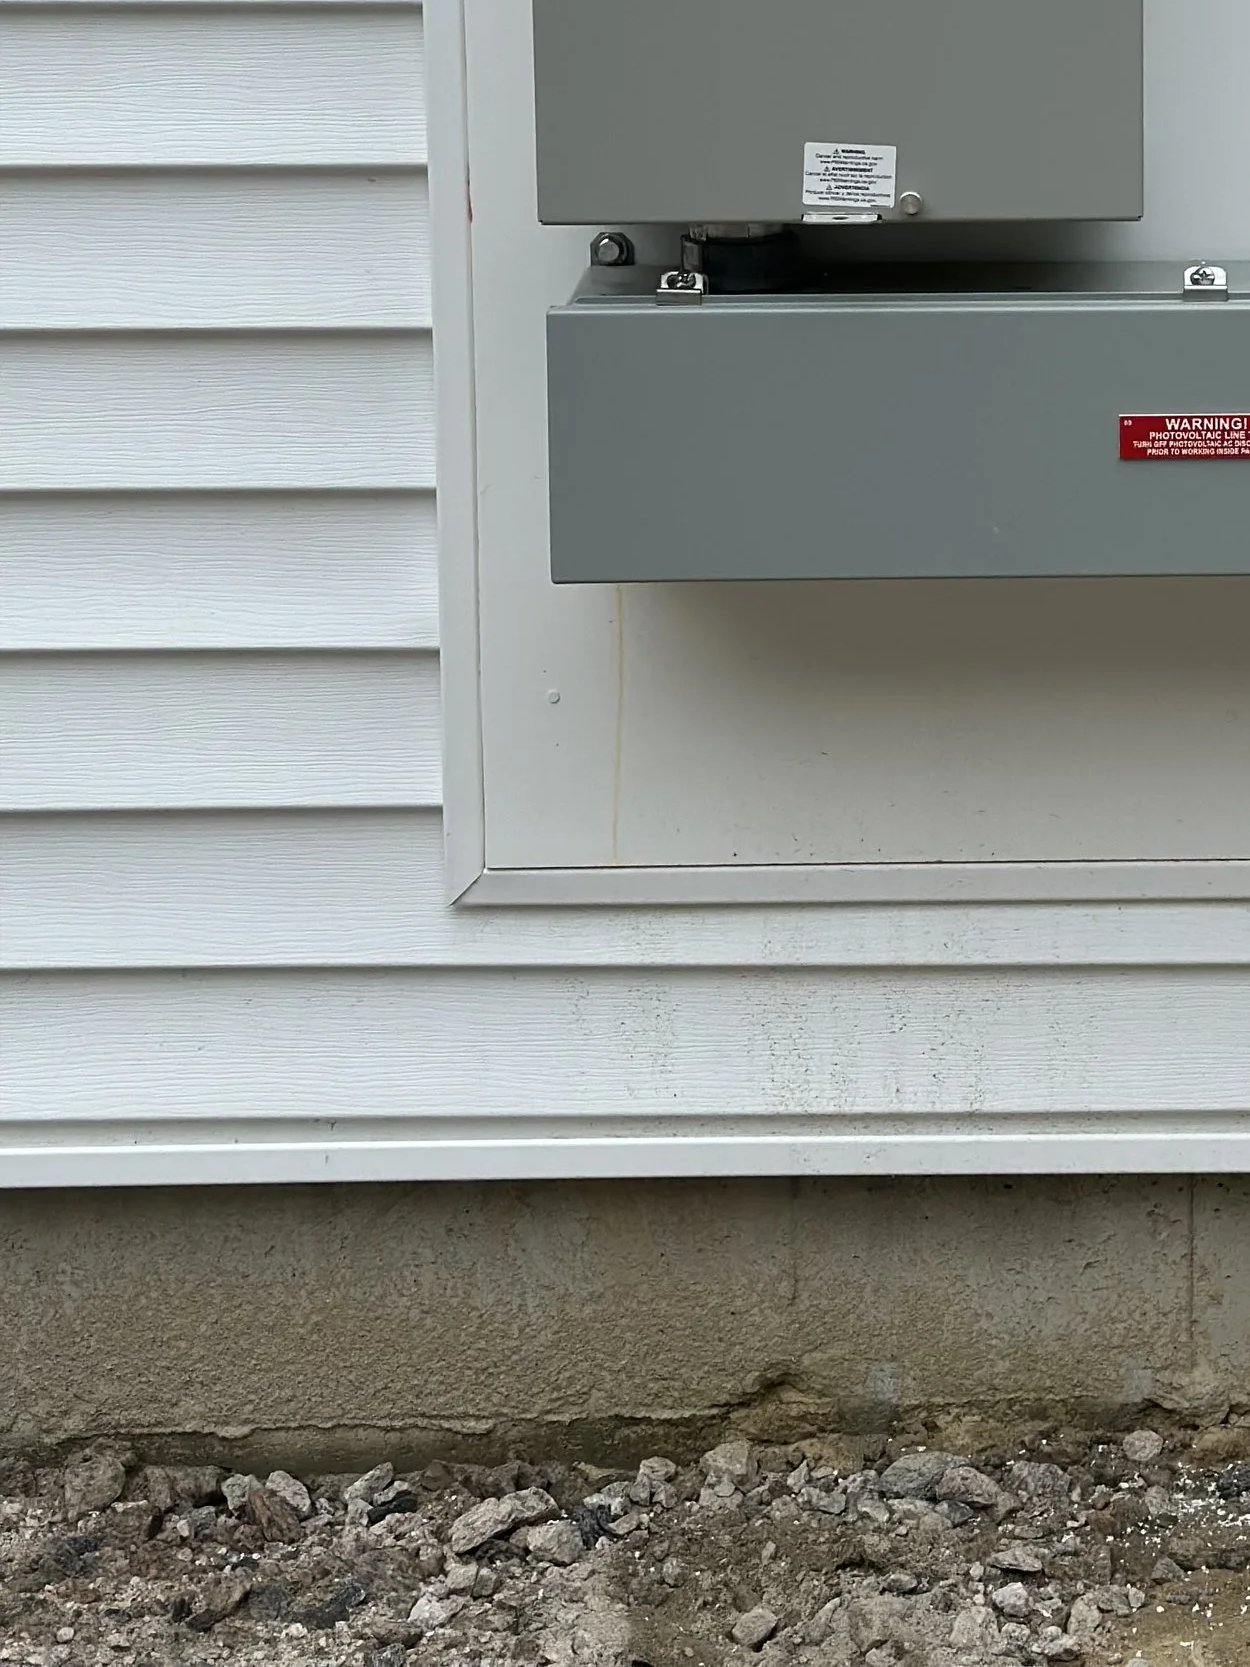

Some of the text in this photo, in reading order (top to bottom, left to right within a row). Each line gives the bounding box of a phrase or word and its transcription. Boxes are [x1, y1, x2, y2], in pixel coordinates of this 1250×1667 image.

[1165, 417, 1247, 430] WARNING!
[1149, 431, 1222, 440] PHOTOVOLTAIC
[1224, 430, 1246, 439] LINE
[1153, 440, 1168, 448] OFF
[1147, 448, 1169, 456] PRIOR
